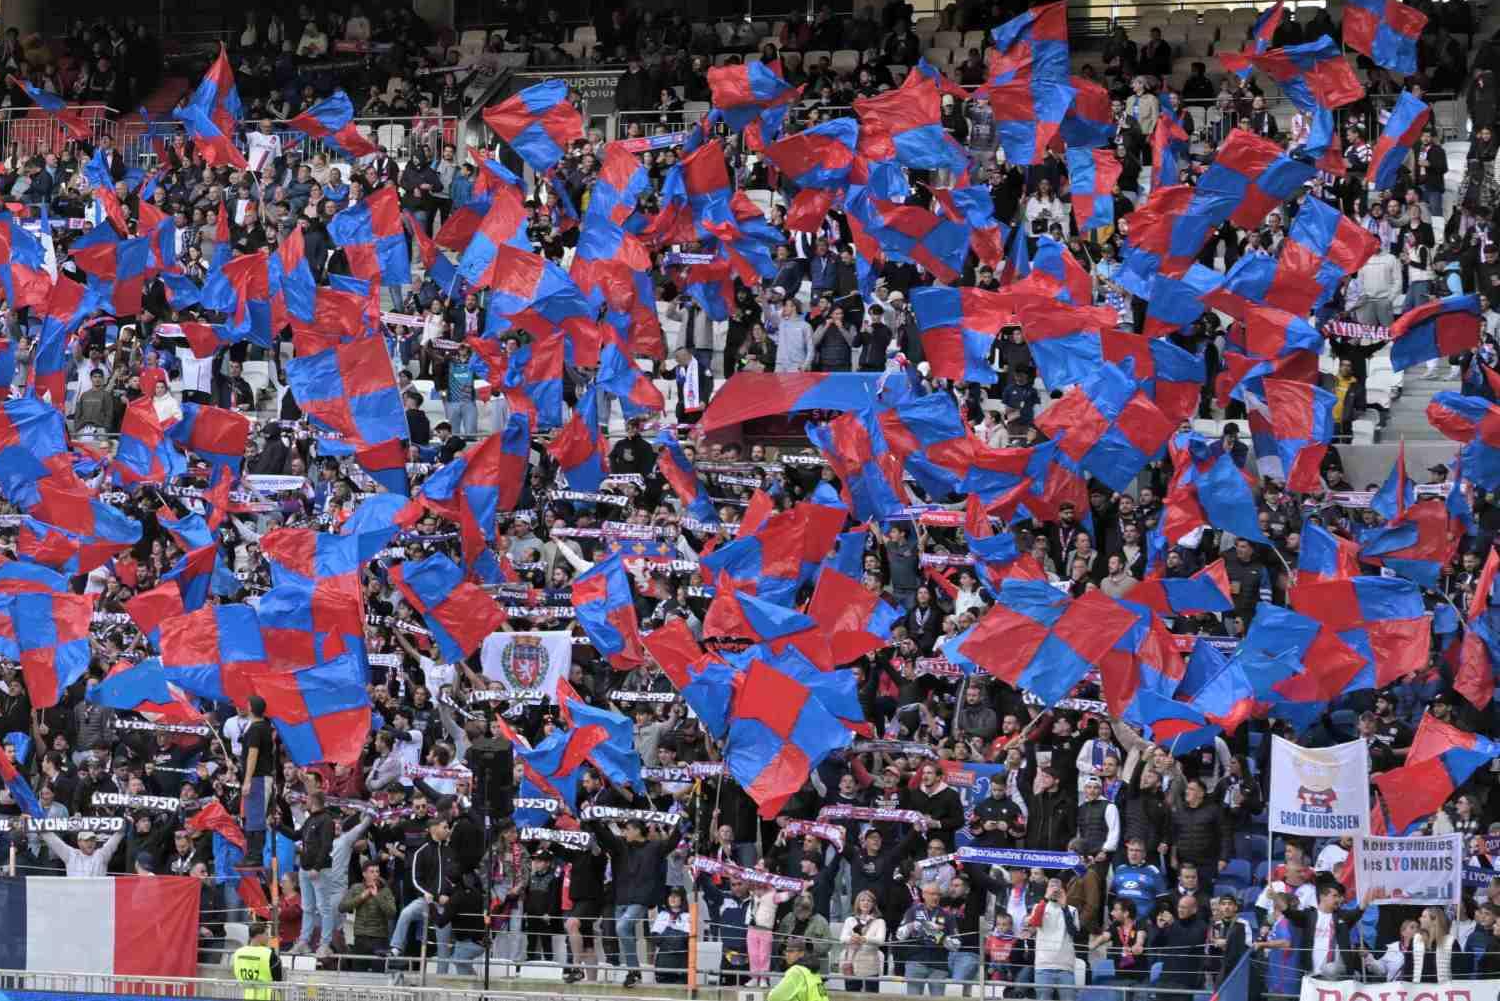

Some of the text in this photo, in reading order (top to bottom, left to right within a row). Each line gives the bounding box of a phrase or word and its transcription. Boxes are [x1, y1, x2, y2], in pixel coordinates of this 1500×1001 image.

[782, 455, 820, 465] LYON
[551, 489, 584, 501] LYON
[115, 718, 210, 736] LYON 1950
[92, 791, 180, 811] LYON 1950
[514, 798, 558, 812] 1950
[28, 816, 123, 831] LYON 1950
[633, 810, 681, 826] 1950
[1280, 811, 1360, 830] CROIX ROUSSIEN
[560, 831, 590, 846] 1950
[1363, 839, 1453, 851] Nous sommes
[1363, 857, 1454, 871] les LYONNAIS
